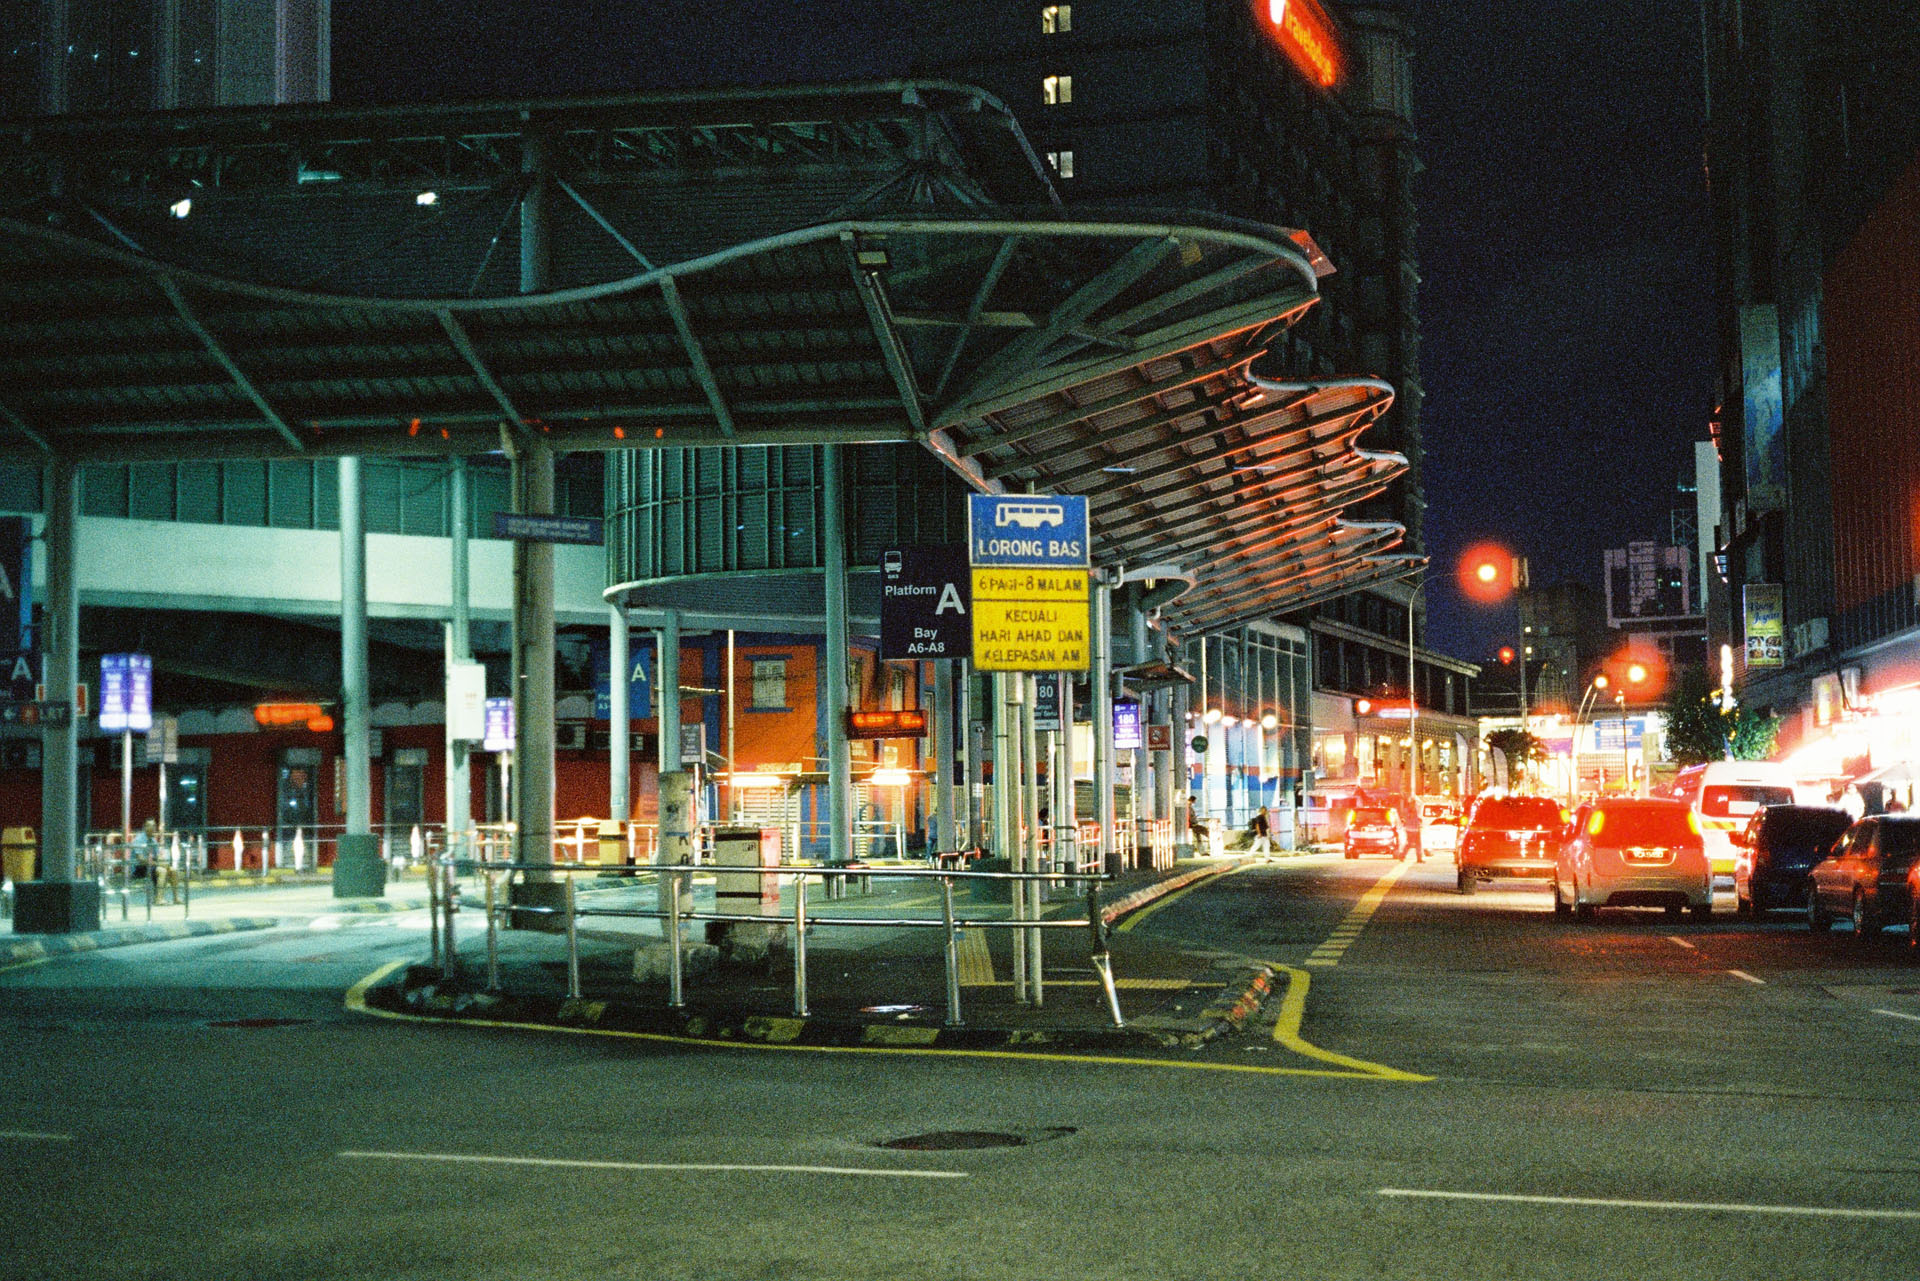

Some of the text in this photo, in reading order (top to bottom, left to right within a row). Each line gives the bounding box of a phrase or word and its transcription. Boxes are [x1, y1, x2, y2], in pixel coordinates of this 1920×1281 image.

[979, 539, 1080, 557] LORONG BAS
[885, 584, 936, 596] Platform
[1037, 578, 1082, 592] MALAM
[935, 582, 966, 615] A
[1005, 609, 1058, 622] KECUALI
[914, 627, 938, 640] Bay
[980, 629, 1083, 643] HARI AHAD DAN
[907, 642, 945, 654] A6-A8
[984, 648, 1081, 662] KELEPASAN AM
[11, 656, 33, 681] A
[631, 662, 647, 682] A
[1118, 713, 1136, 725] 180
